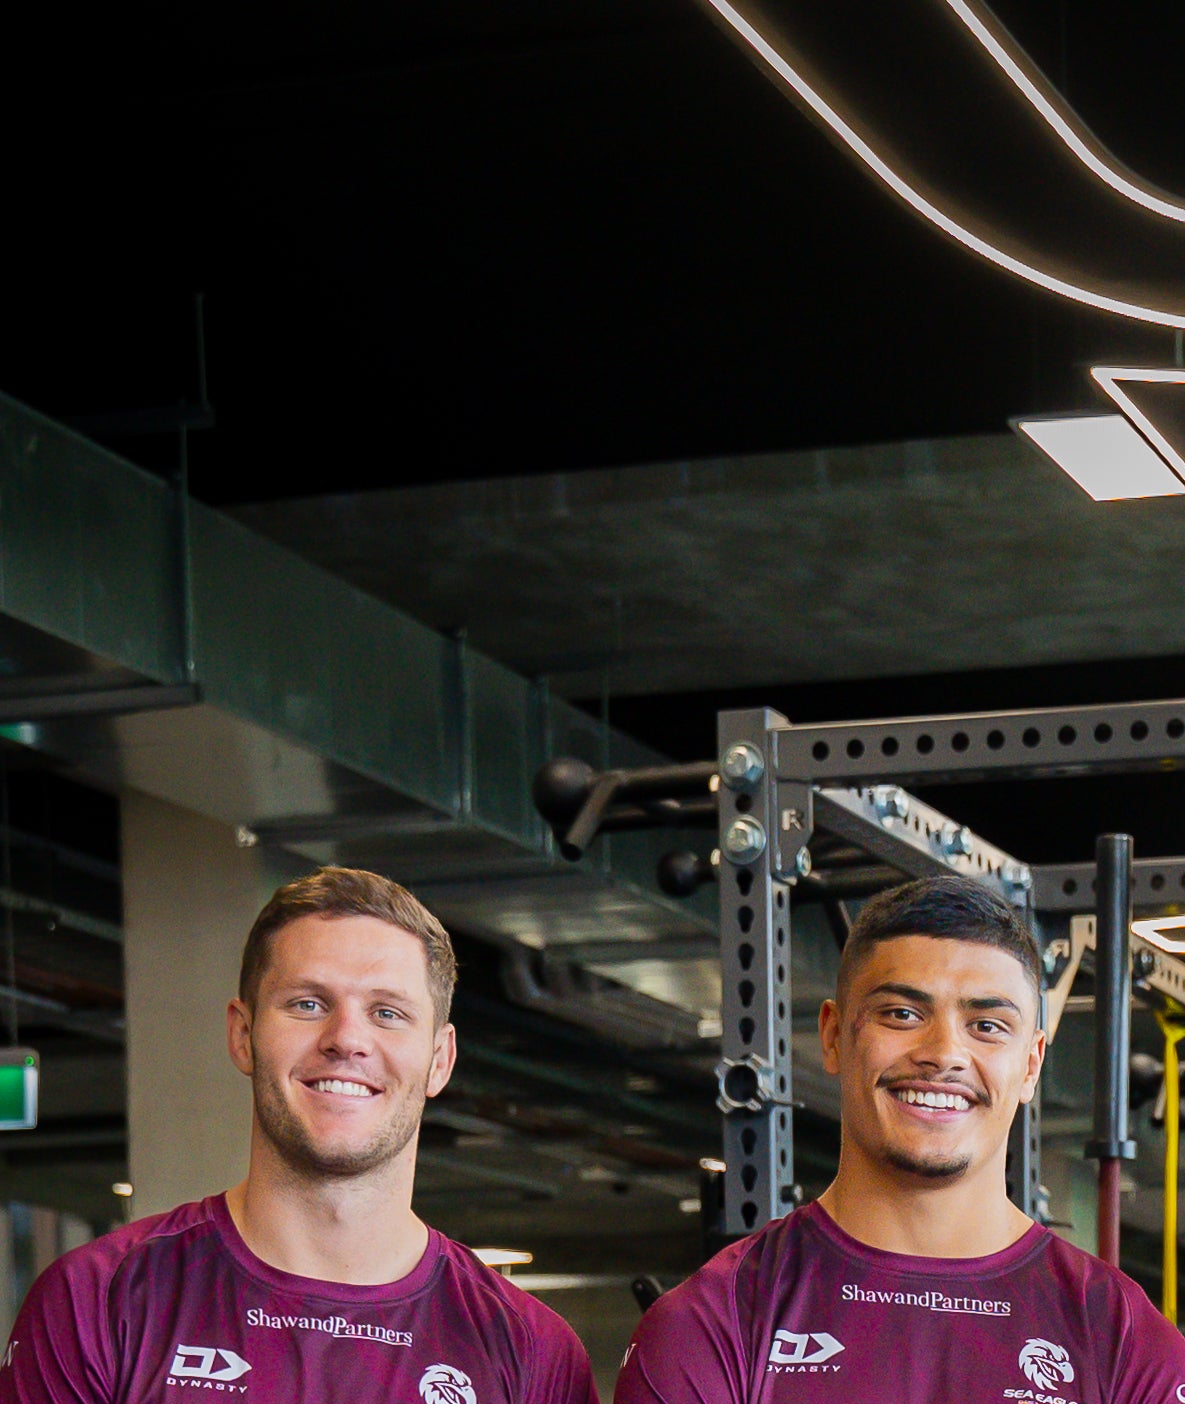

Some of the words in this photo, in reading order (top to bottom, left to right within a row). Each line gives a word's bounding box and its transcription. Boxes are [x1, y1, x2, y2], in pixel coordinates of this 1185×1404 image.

[842, 1284, 1011, 1314] ShawandPartners
[246, 1308, 413, 1344] ShawandPartners
[166, 1377, 248, 1394] DYNASTY
[1003, 1388, 1033, 1400] SEA
